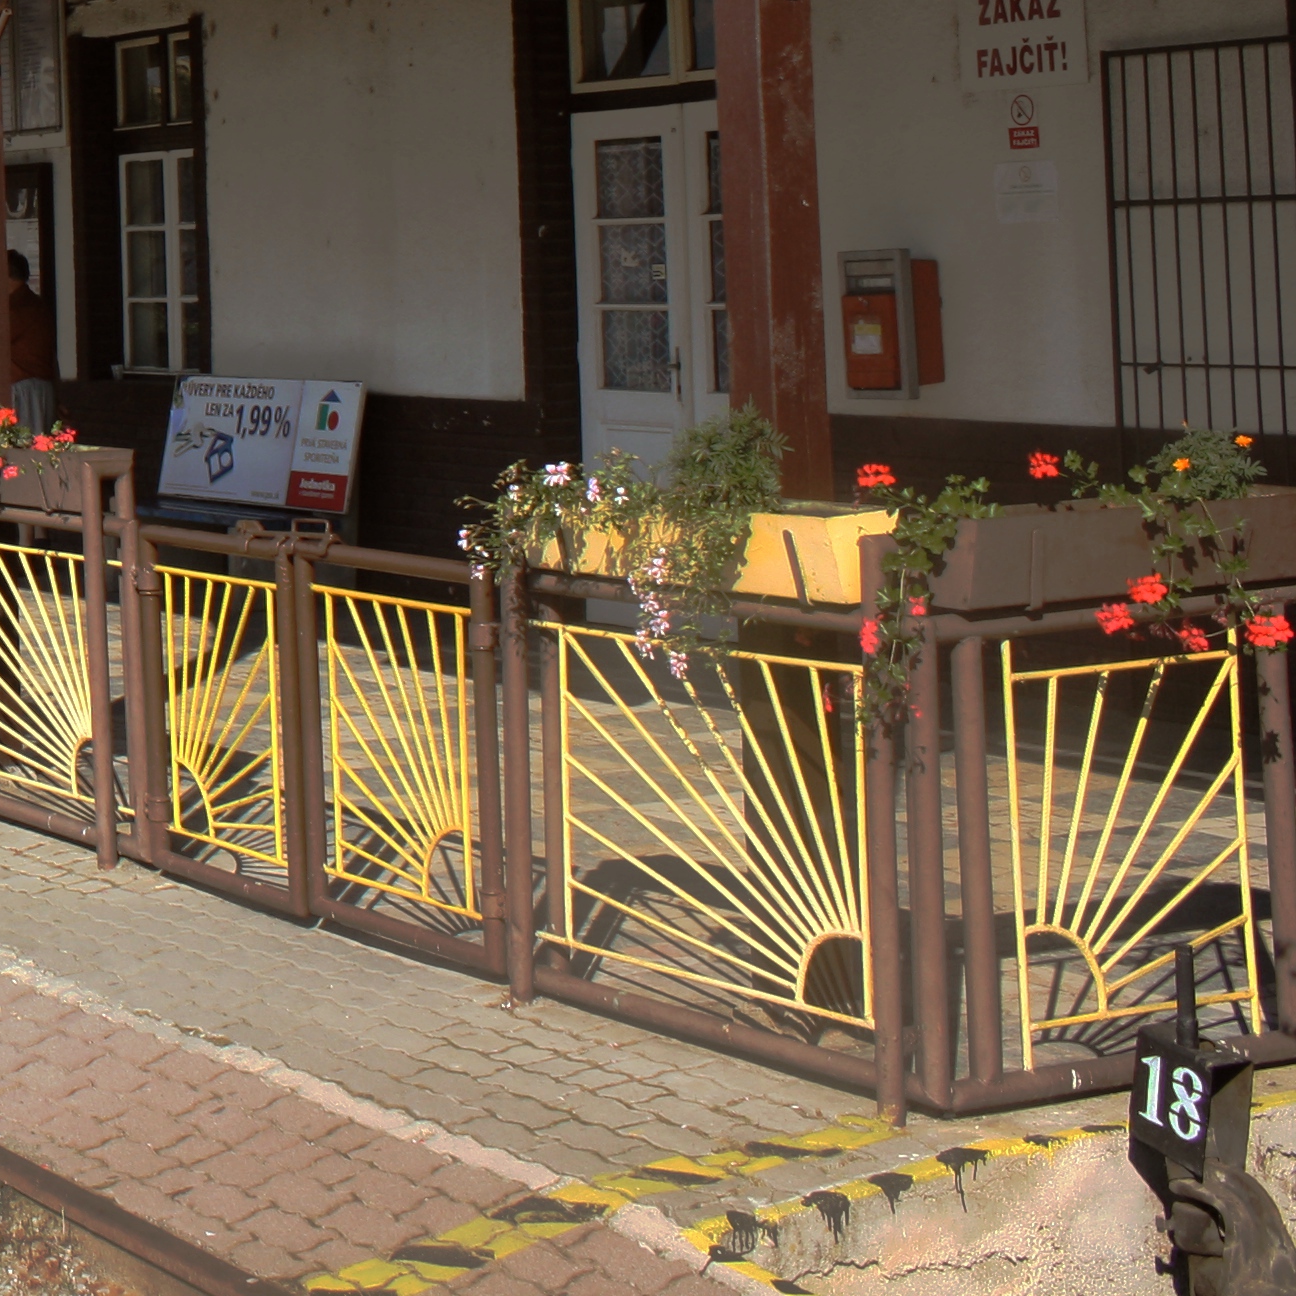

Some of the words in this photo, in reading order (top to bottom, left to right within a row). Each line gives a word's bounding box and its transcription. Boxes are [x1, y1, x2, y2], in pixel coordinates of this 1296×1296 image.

[976, 35, 1068, 78] FAJČIŤ!
[215, 383, 233, 398] PRE
[233, 382, 276, 400] KAŽDÉHO
[205, 402, 222, 416] LEN
[222, 403, 234, 417] ZA
[1137, 1055, 1206, 1141] 18
